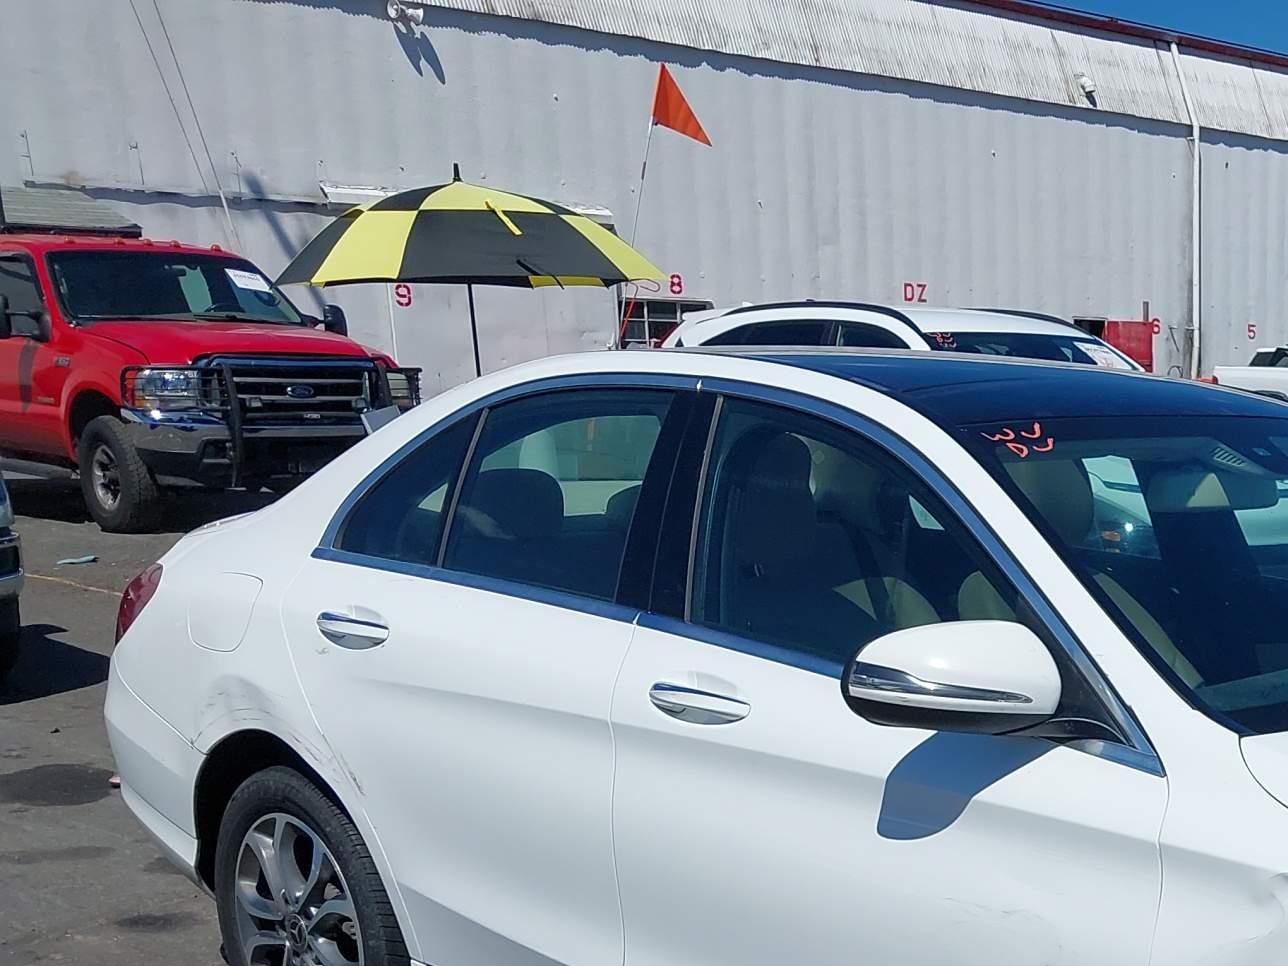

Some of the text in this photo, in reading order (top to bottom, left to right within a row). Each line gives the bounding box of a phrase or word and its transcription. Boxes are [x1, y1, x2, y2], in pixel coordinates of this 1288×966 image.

[670, 274, 683, 295] 8
[395, 283, 412, 307] 9
[1151, 318, 1161, 335] 6
[1247, 323, 1257, 340] 5
